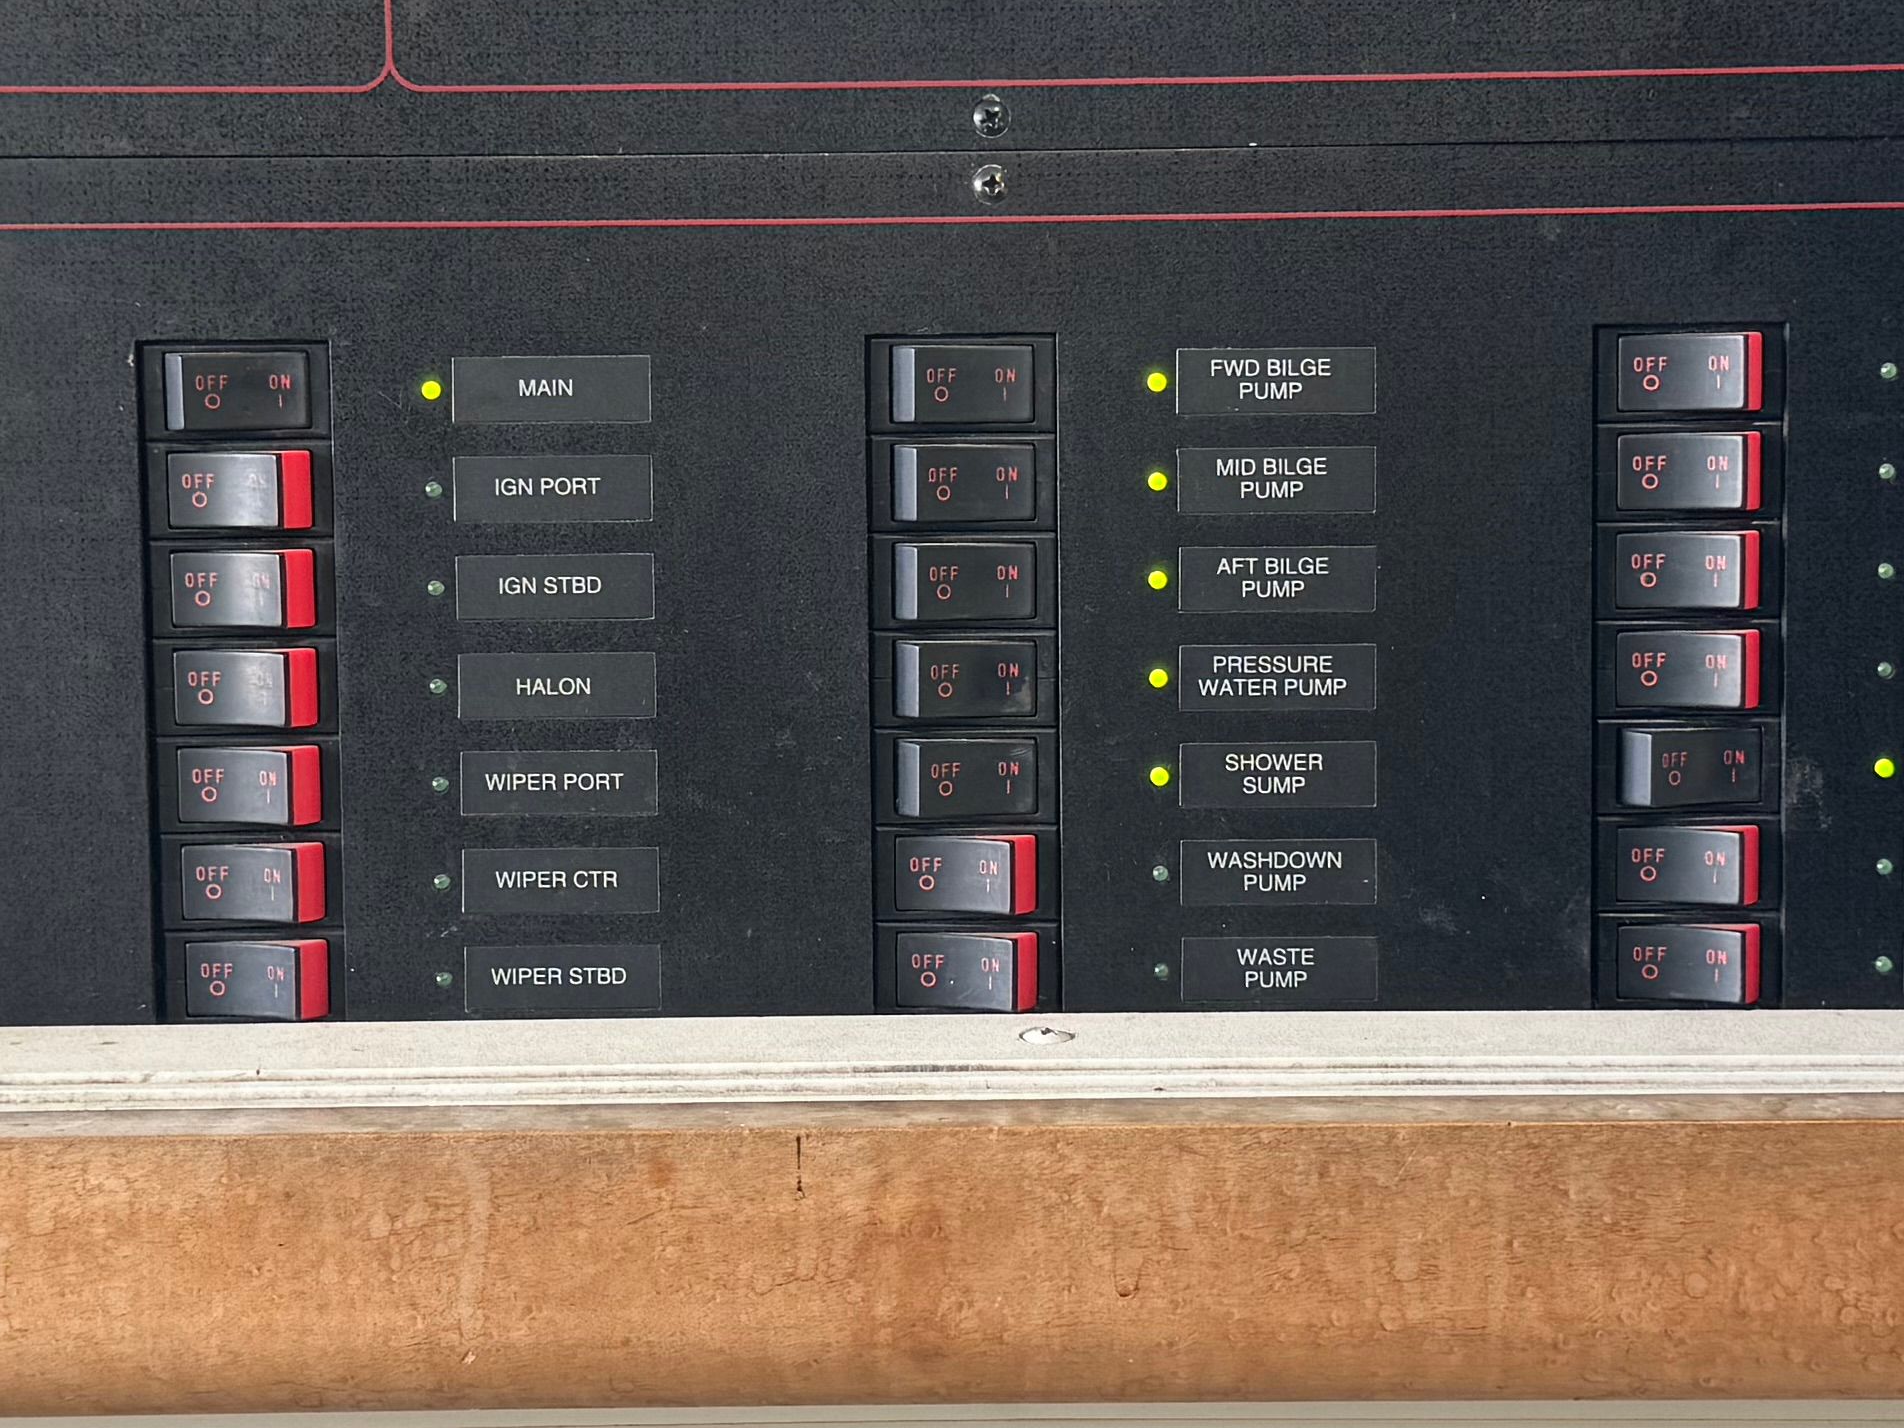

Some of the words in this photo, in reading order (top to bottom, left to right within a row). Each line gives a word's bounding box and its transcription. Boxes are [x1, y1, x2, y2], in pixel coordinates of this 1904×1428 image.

[1210, 358, 1260, 377] FWD
[1267, 358, 1332, 377] BILGE
[518, 378, 573, 397] MAIN
[1239, 381, 1303, 400] PUMP
[495, 477, 533, 496] IGN
[540, 477, 601, 496] PORT
[1213, 655, 1333, 674] PRESSURE
[516, 677, 591, 696] HALON
[1198, 678, 1277, 697] WATER
[1284, 678, 1347, 696] PUMP
[1207, 851, 1342, 869] WASHDOWN
[1243, 873, 1307, 892] PUMP
[491, 967, 562, 986] WIPER
[569, 967, 627, 985] STBD
